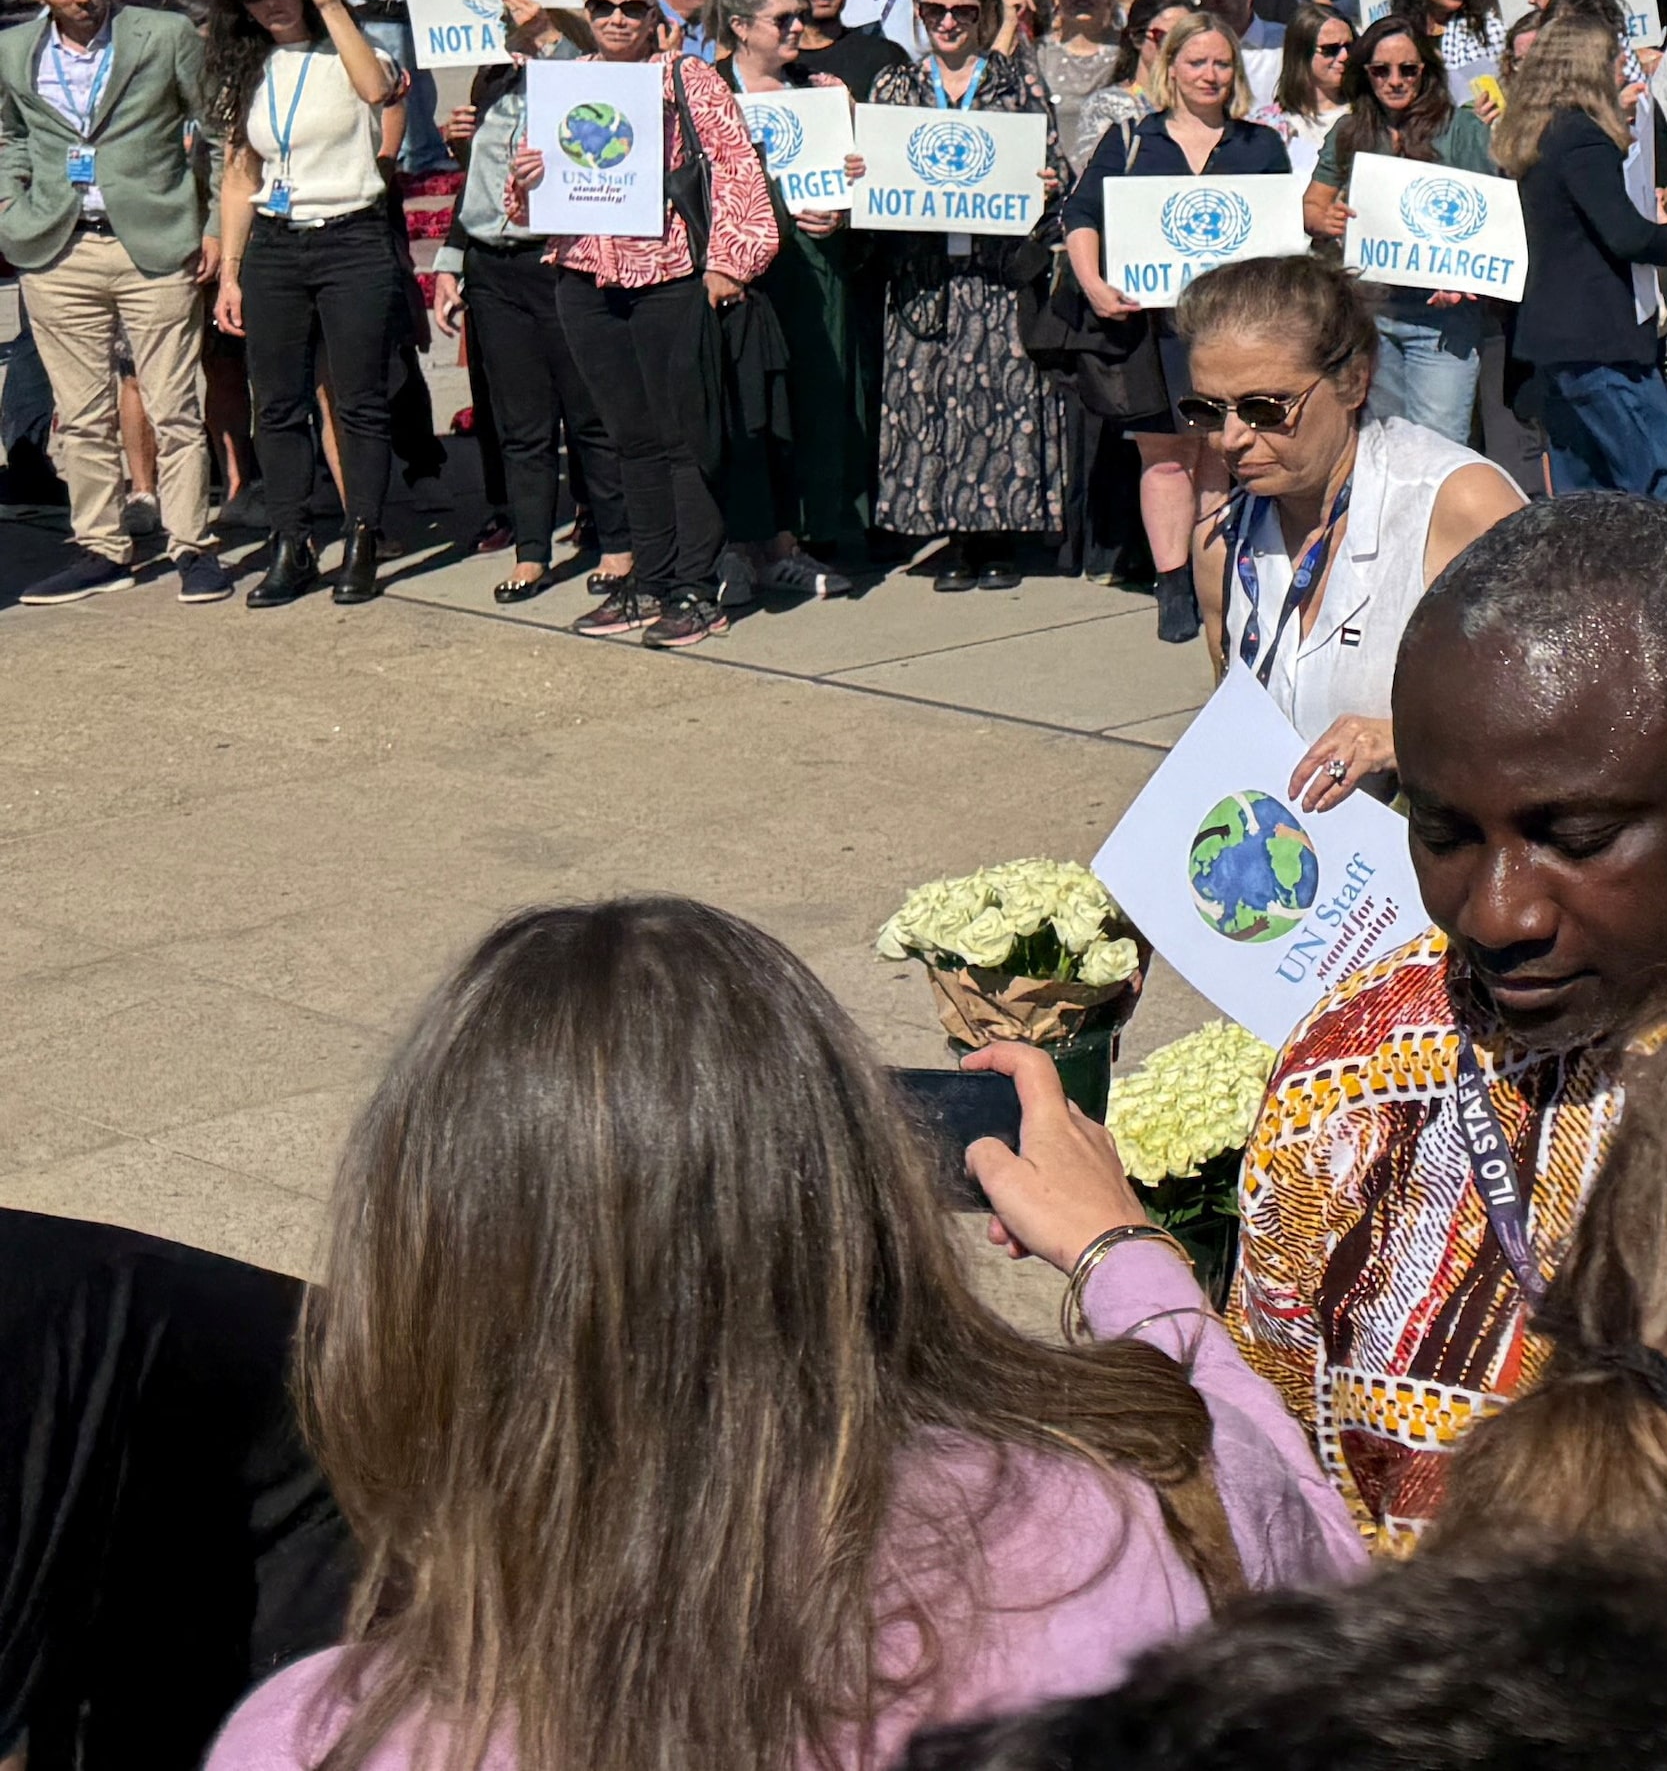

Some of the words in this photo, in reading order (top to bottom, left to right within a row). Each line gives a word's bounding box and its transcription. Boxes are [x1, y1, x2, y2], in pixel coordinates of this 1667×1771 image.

[429, 25, 474, 54] NOT
[481, 24, 496, 50] A
[562, 171, 595, 185] UN
[598, 170, 637, 185] Staff
[782, 169, 845, 201] RGET
[868, 187, 916, 217] NOT
[921, 190, 936, 217] A
[942, 191, 1030, 221] TARGET
[1124, 262, 1173, 294] NOT
[1361, 238, 1404, 268] NOT
[1406, 243, 1421, 271] A
[1427, 245, 1515, 285] TARGET
[1275, 925, 1328, 985] UN
[1315, 851, 1377, 928] Staff
[1316, 921, 1357, 981] stand
[1349, 895, 1377, 932] for
[1457, 1072, 1499, 1156] STAFF
[1480, 1158, 1516, 1206] ILO
